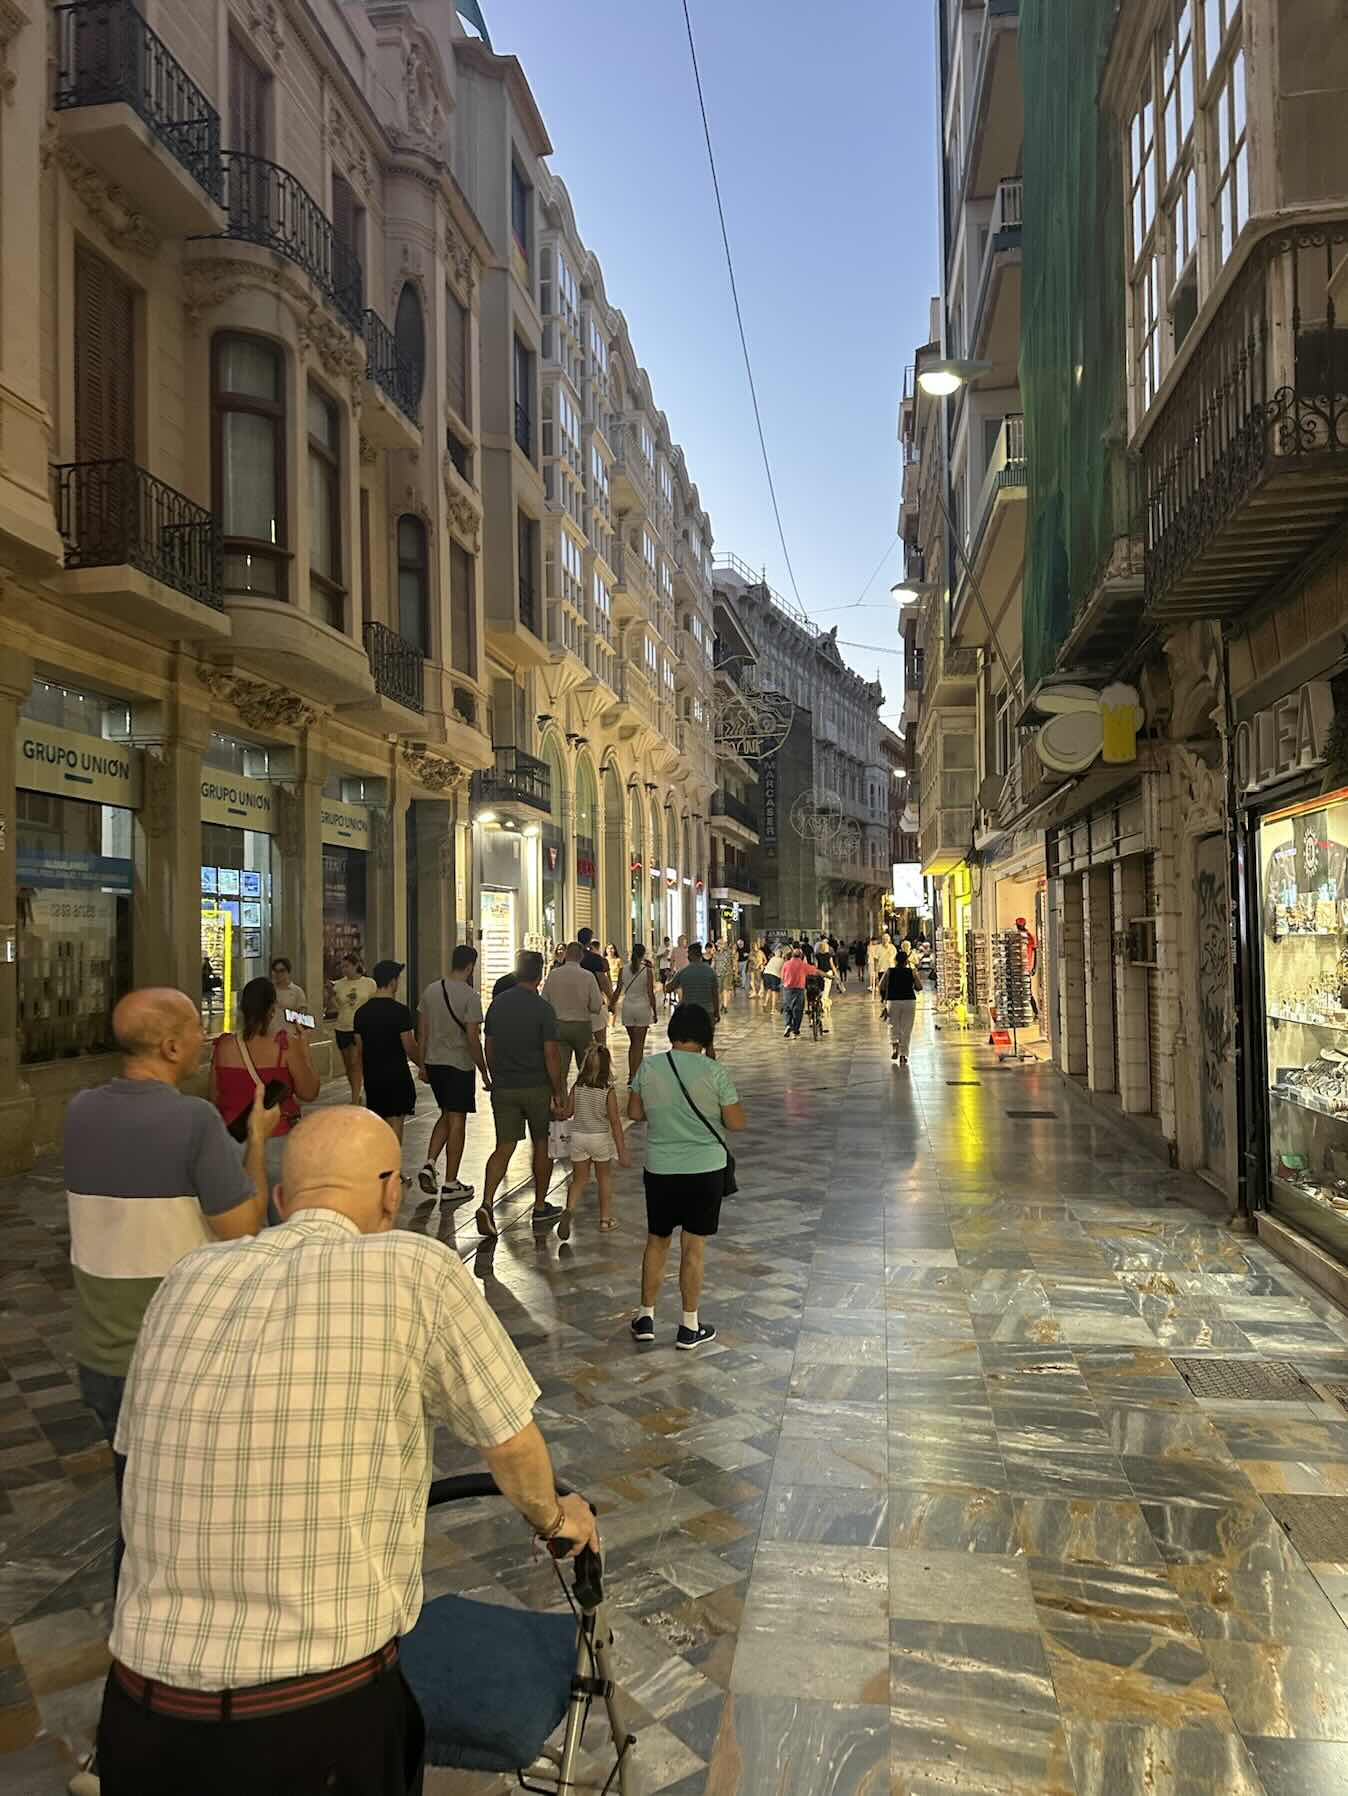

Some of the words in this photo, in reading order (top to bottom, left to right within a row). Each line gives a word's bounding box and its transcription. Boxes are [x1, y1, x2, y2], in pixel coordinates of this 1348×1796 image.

[1235, 682, 1325, 791] OLEA
[23, 740, 77, 769] GRUPO
[82, 753, 130, 779] UNIÓN
[201, 782, 237, 804] GRUPO
[320, 811, 344, 826] GRUPO
